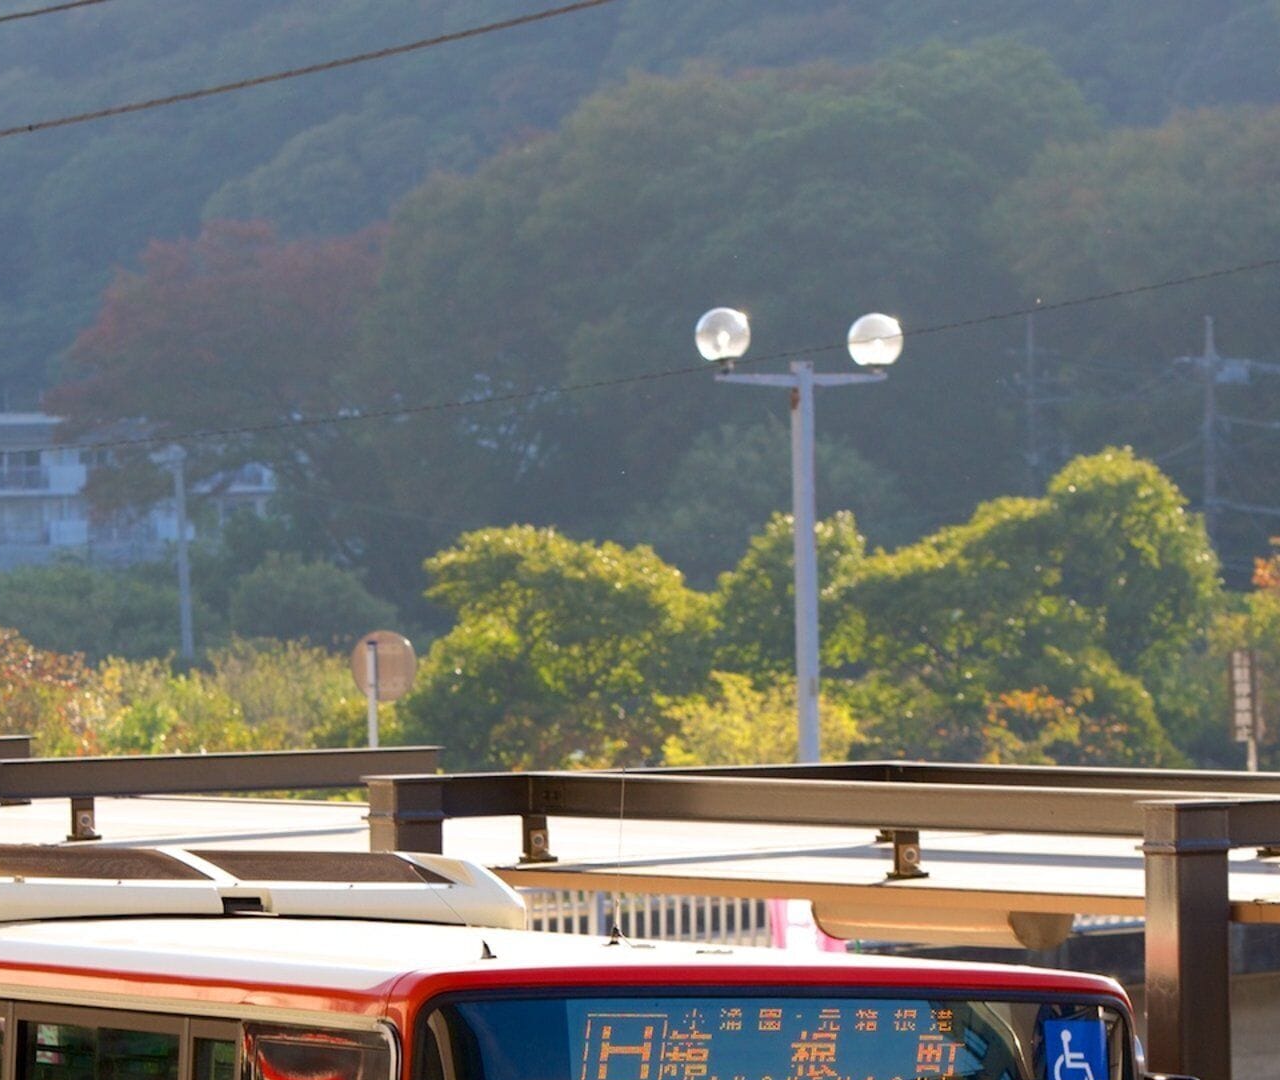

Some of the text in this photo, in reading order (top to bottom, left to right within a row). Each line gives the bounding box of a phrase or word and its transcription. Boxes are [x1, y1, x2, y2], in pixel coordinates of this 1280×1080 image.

[598, 1025, 654, 1080] H
[664, 1029, 965, 1077] 箱根町
